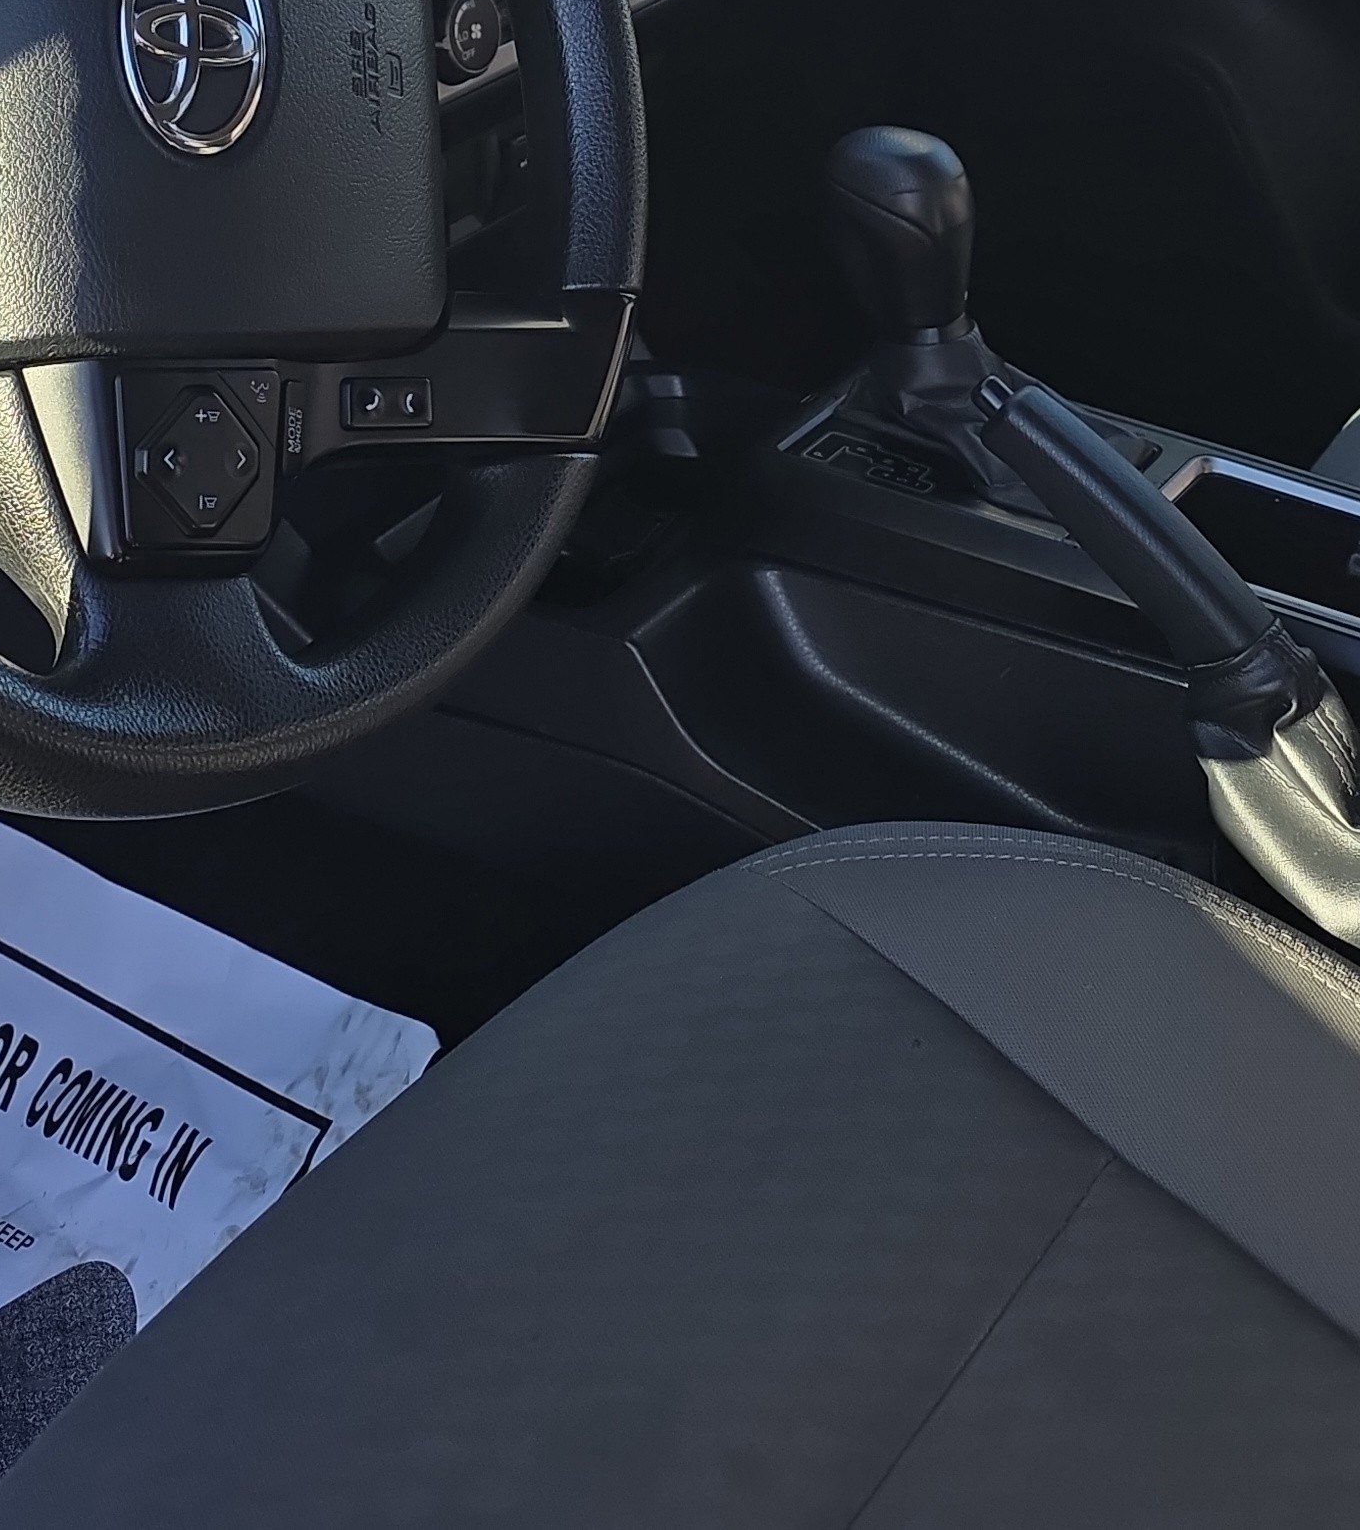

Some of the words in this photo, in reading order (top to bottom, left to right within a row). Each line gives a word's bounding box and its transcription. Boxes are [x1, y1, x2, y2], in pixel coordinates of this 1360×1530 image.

[287, 406, 297, 453] MODE
[25, 1057, 165, 1182] COMING
[148, 1122, 214, 1211] IN
